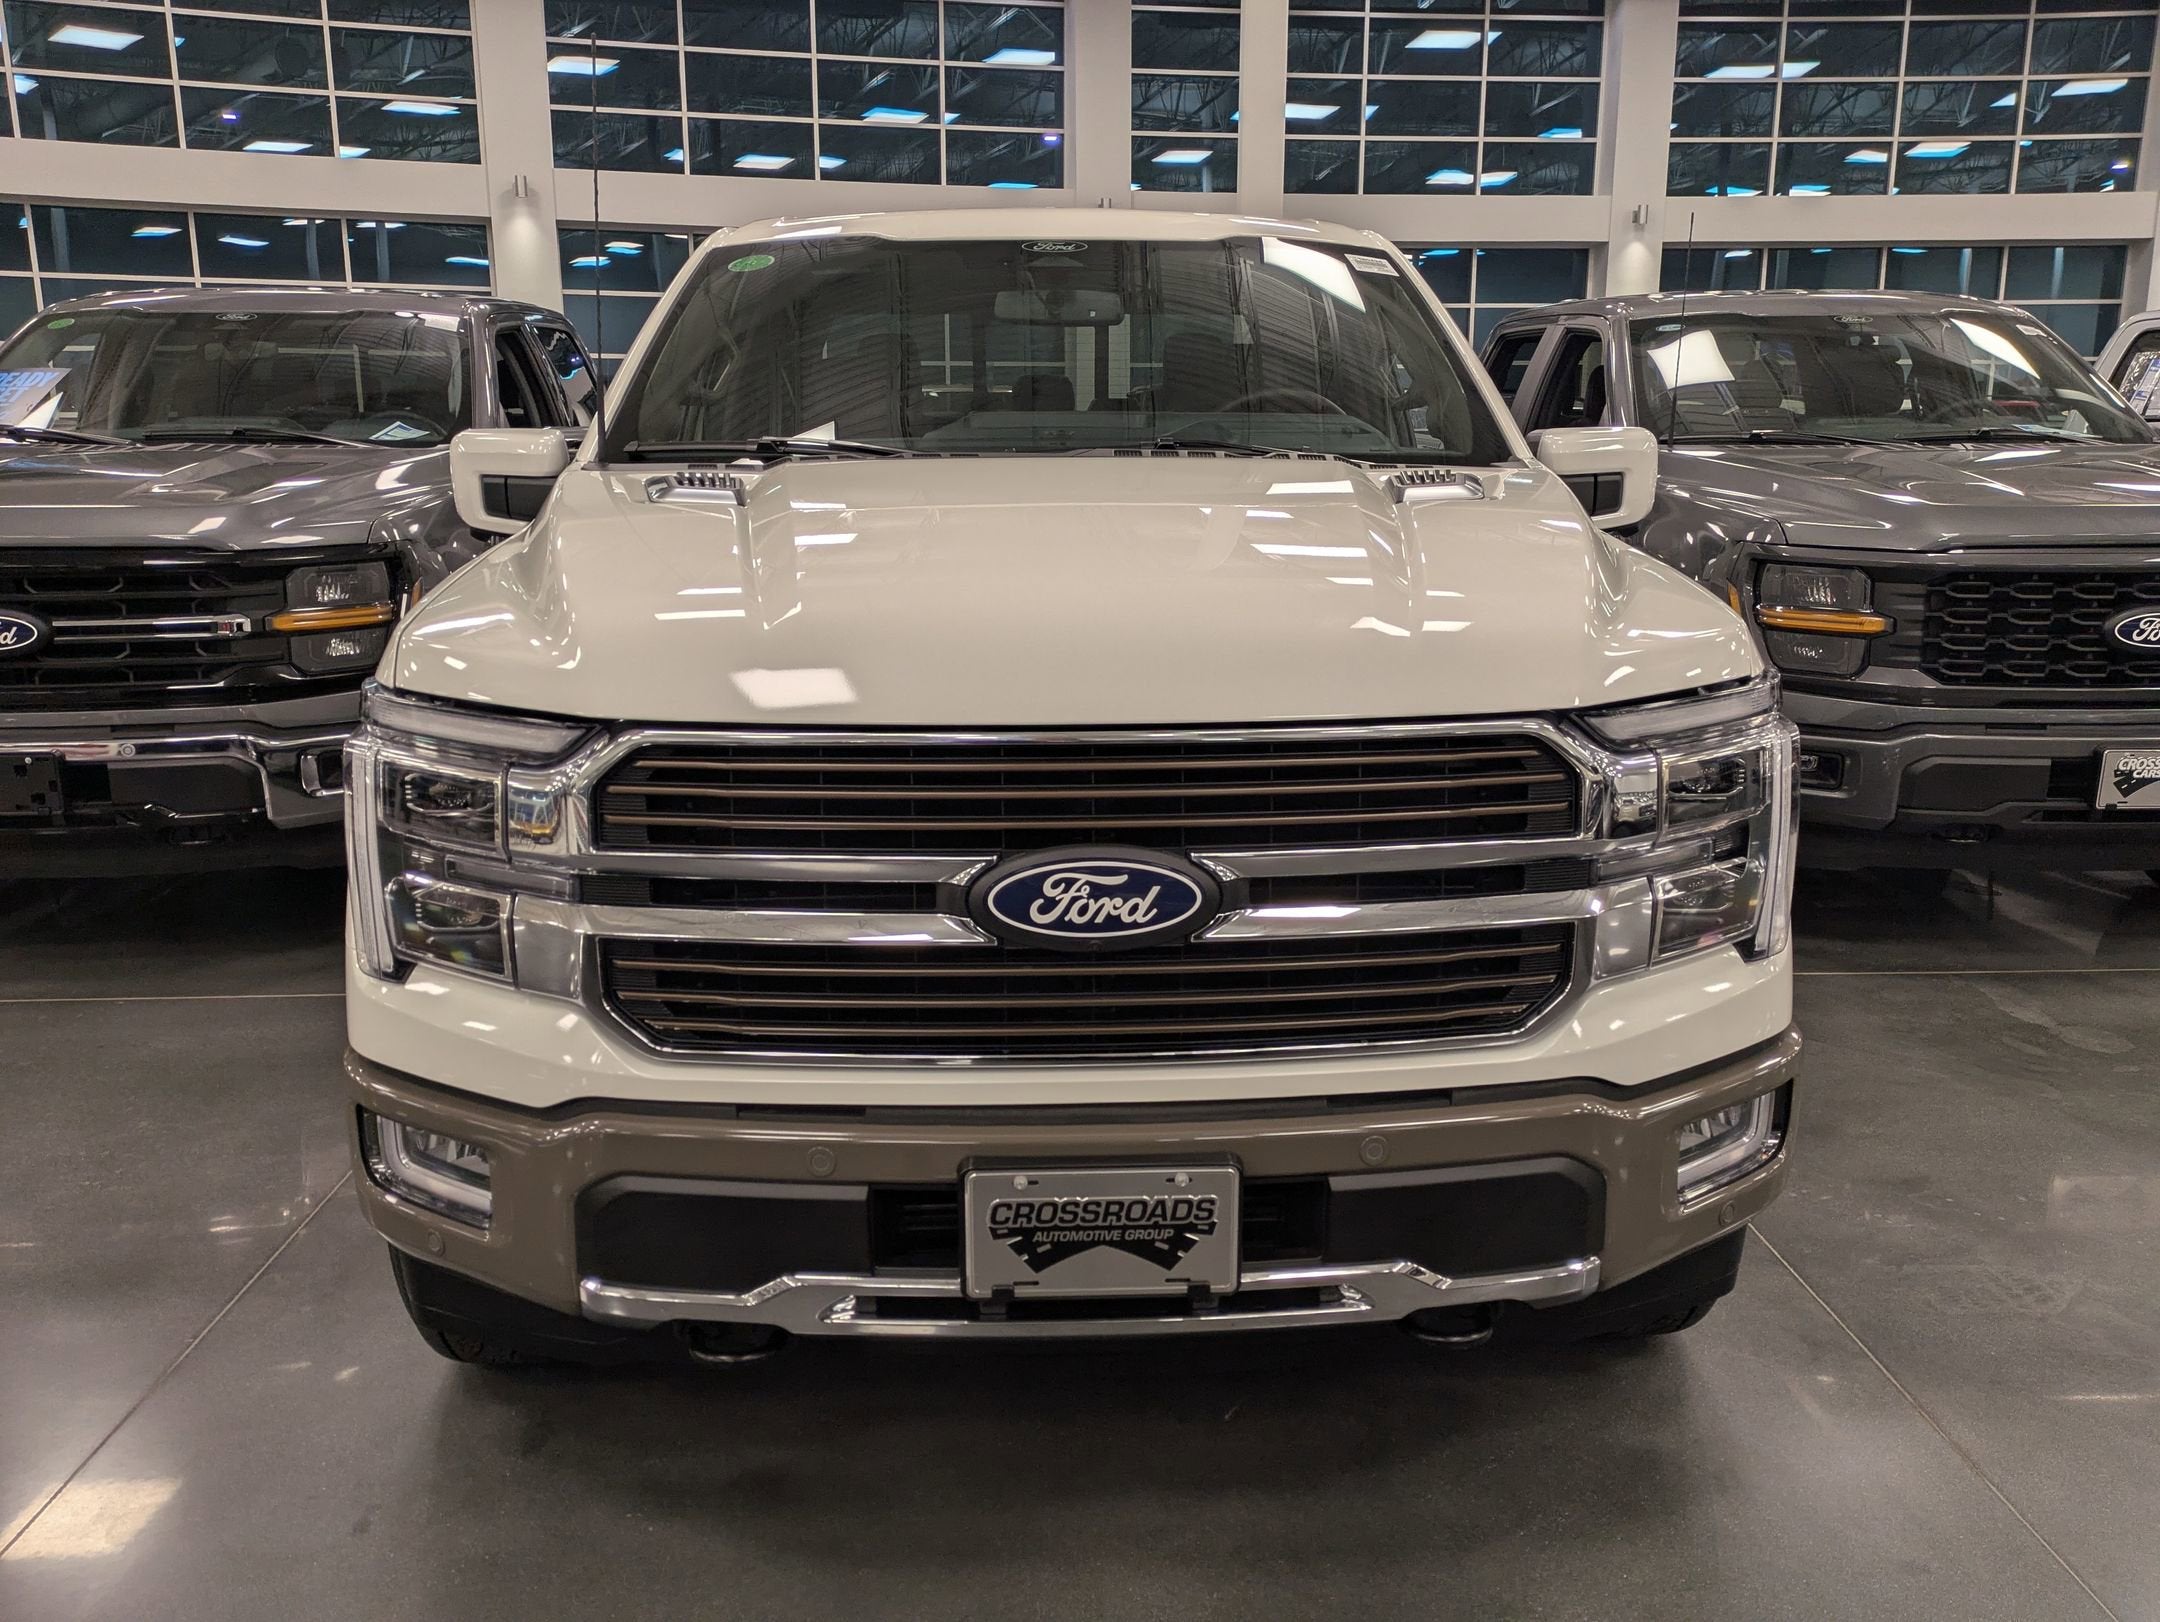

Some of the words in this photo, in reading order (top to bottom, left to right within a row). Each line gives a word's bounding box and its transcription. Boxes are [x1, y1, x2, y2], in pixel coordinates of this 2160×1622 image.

[1032, 241, 1077, 251] Ford
[1029, 872, 1161, 925] Ford
[989, 1197, 1217, 1228] CROSSROADS
[1032, 1229, 1122, 1243] AUTOMOTIVE
[1124, 1228, 1175, 1242] GROUP
